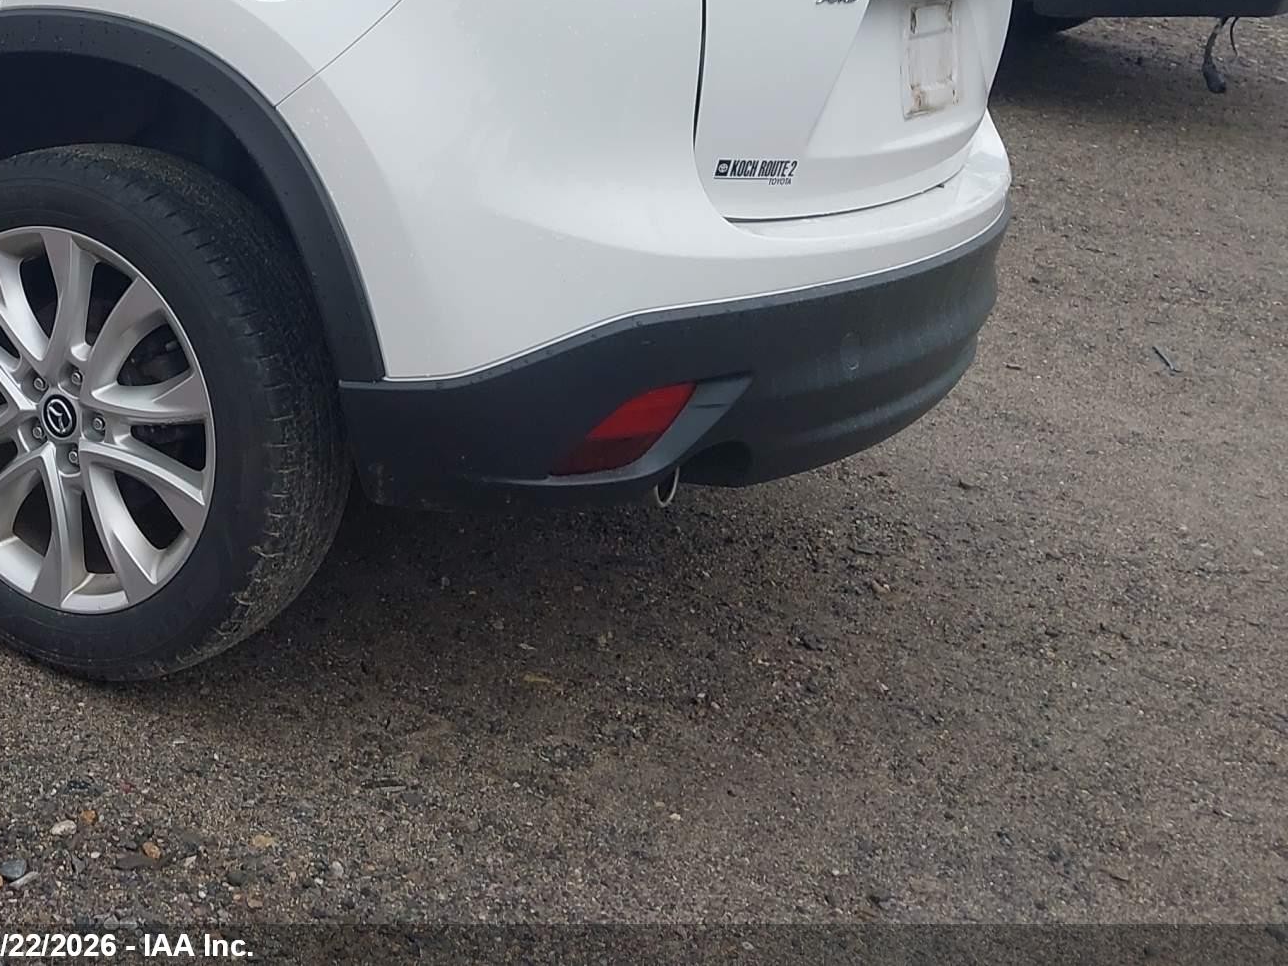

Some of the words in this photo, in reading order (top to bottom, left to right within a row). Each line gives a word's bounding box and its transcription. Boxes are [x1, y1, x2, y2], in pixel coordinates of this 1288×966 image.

[730, 160, 759, 177] KOCH
[758, 160, 791, 177] ROUTE
[787, 160, 798, 177] 2
[768, 178, 792, 186] TOYOTA
